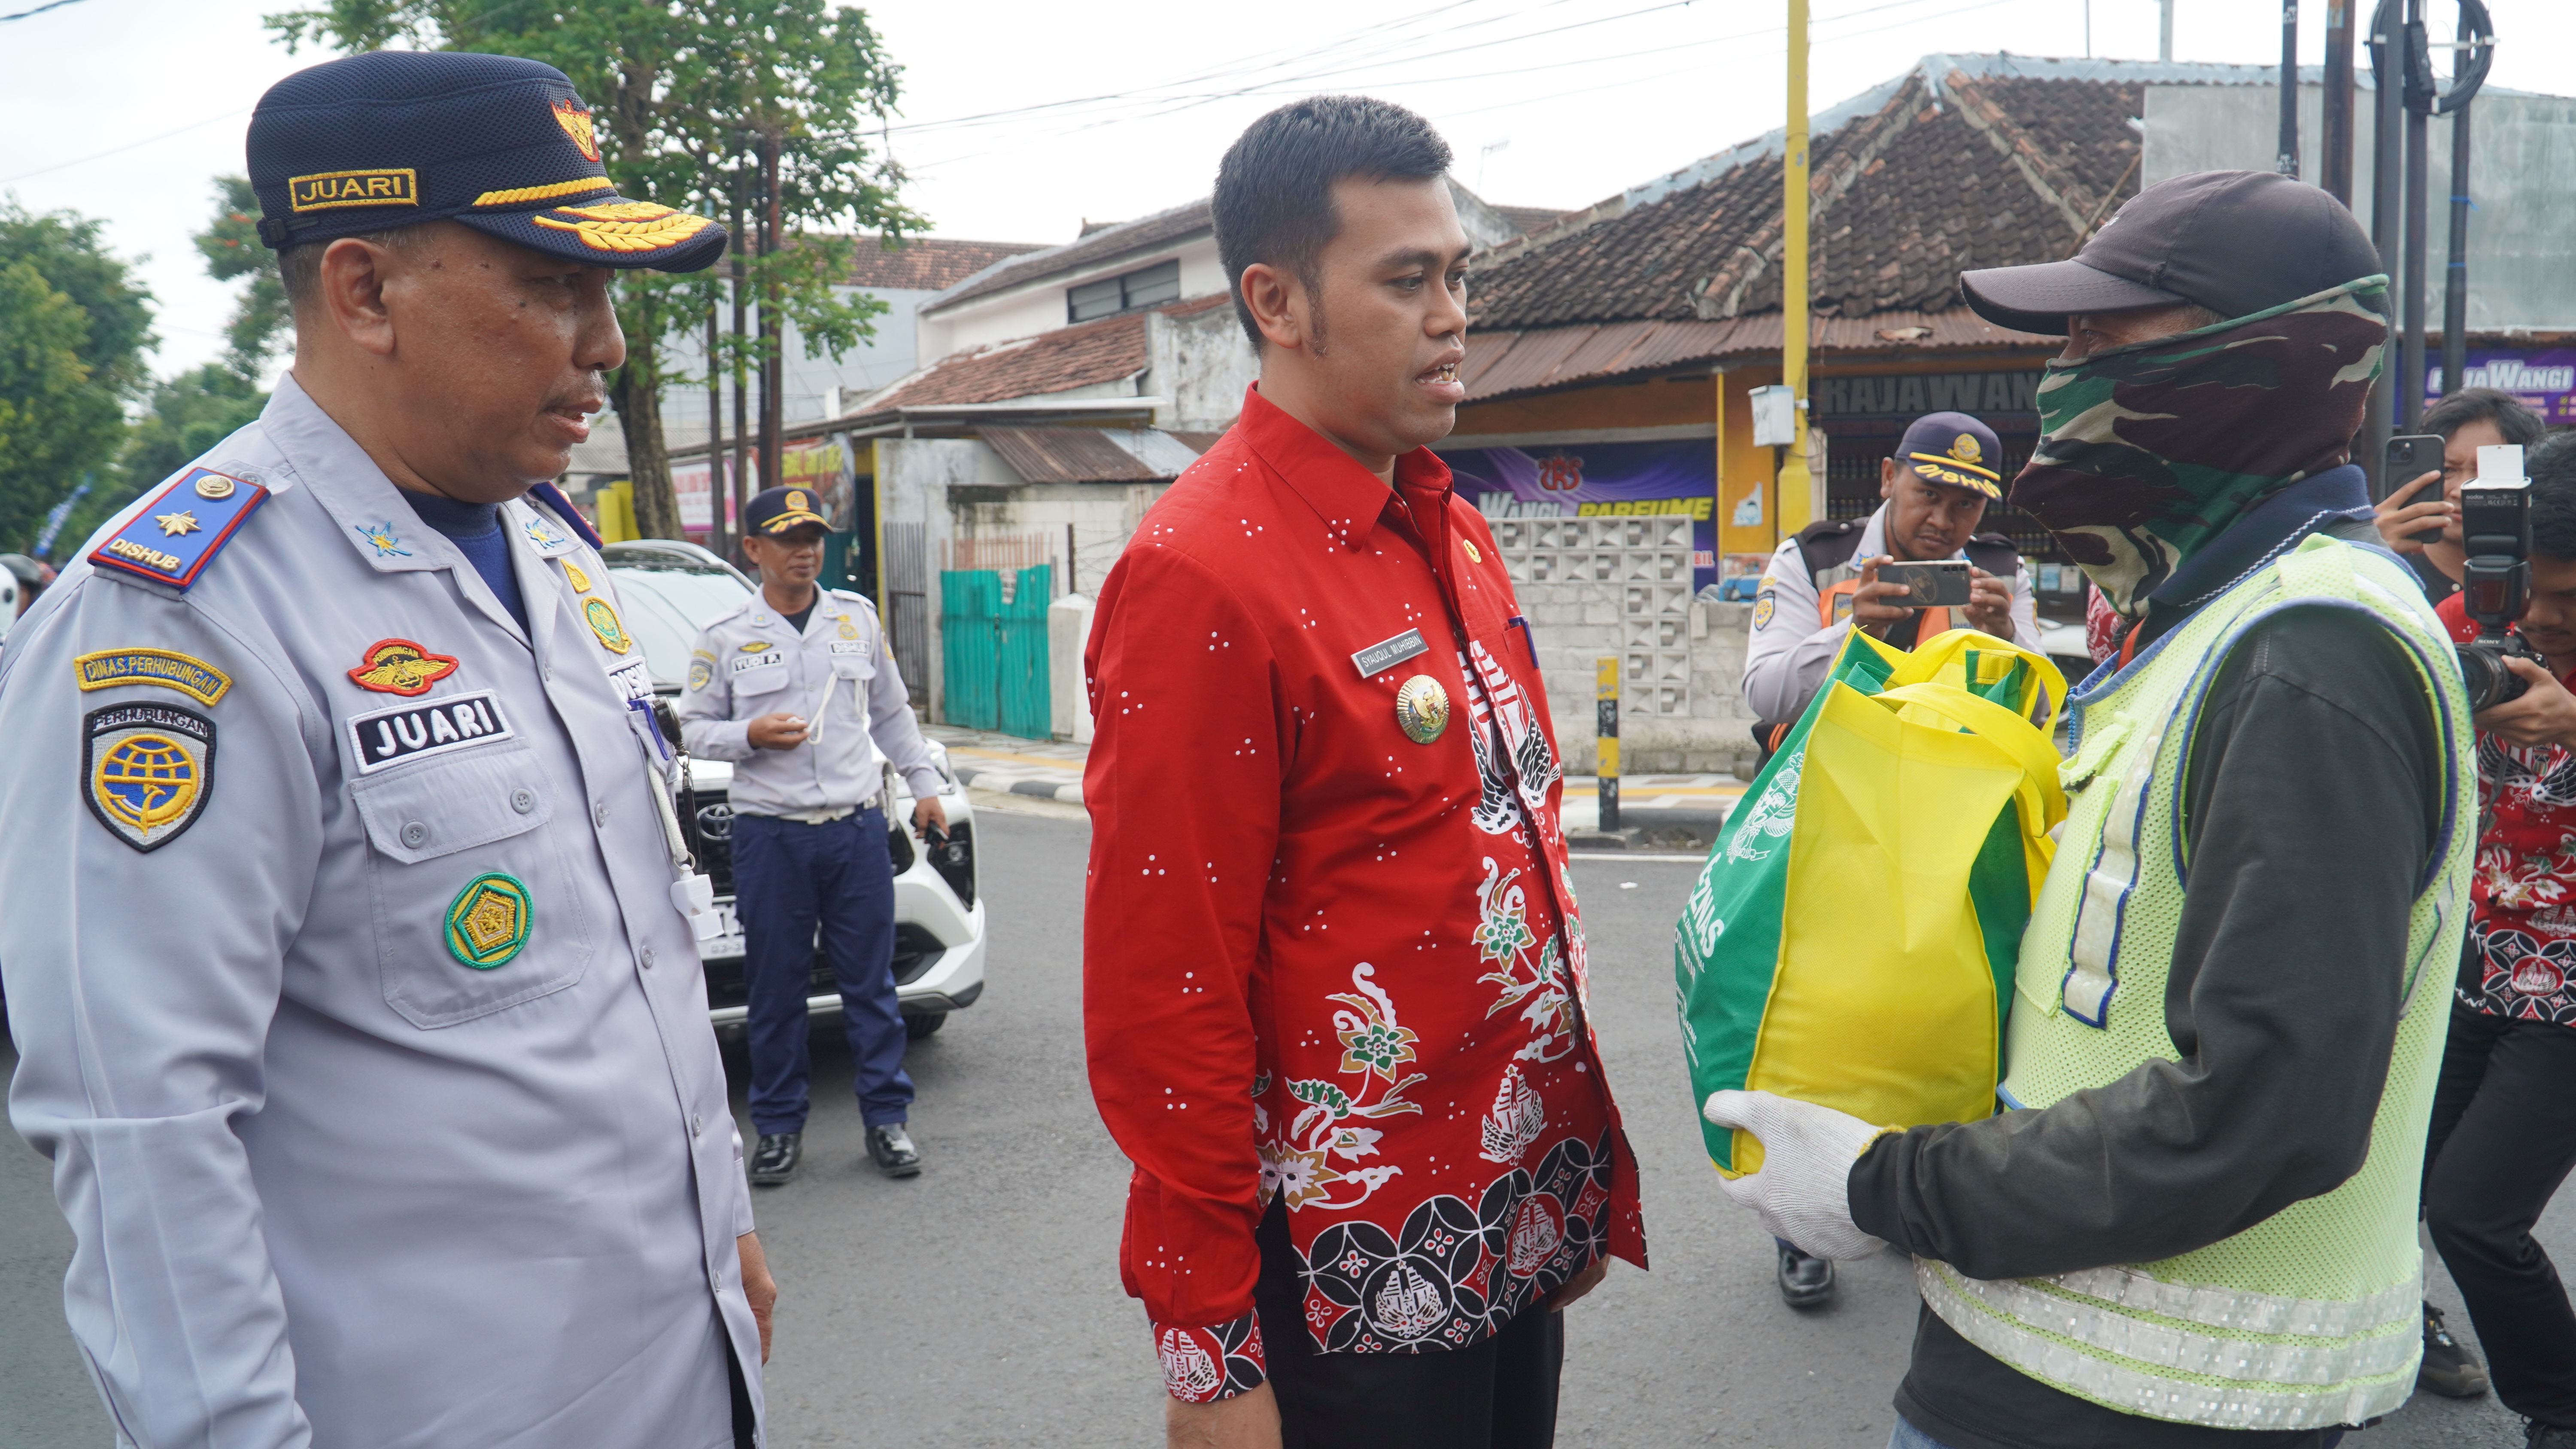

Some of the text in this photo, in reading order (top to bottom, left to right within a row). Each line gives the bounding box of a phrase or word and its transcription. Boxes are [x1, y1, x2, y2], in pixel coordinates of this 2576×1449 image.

[301, 176, 402, 201] JUARI
[109, 538, 182, 573] DISHUB
[373, 646, 419, 665] PERHUBUNGAN
[735, 655, 764, 670] YUDI
[1361, 634, 1422, 667] SYAUQUL MUHIBBIN
[86, 657, 219, 694] DINAS PERHUBUNGAN
[93, 708, 208, 737] PERHUBUNGAN
[376, 700, 494, 756] JUARI
